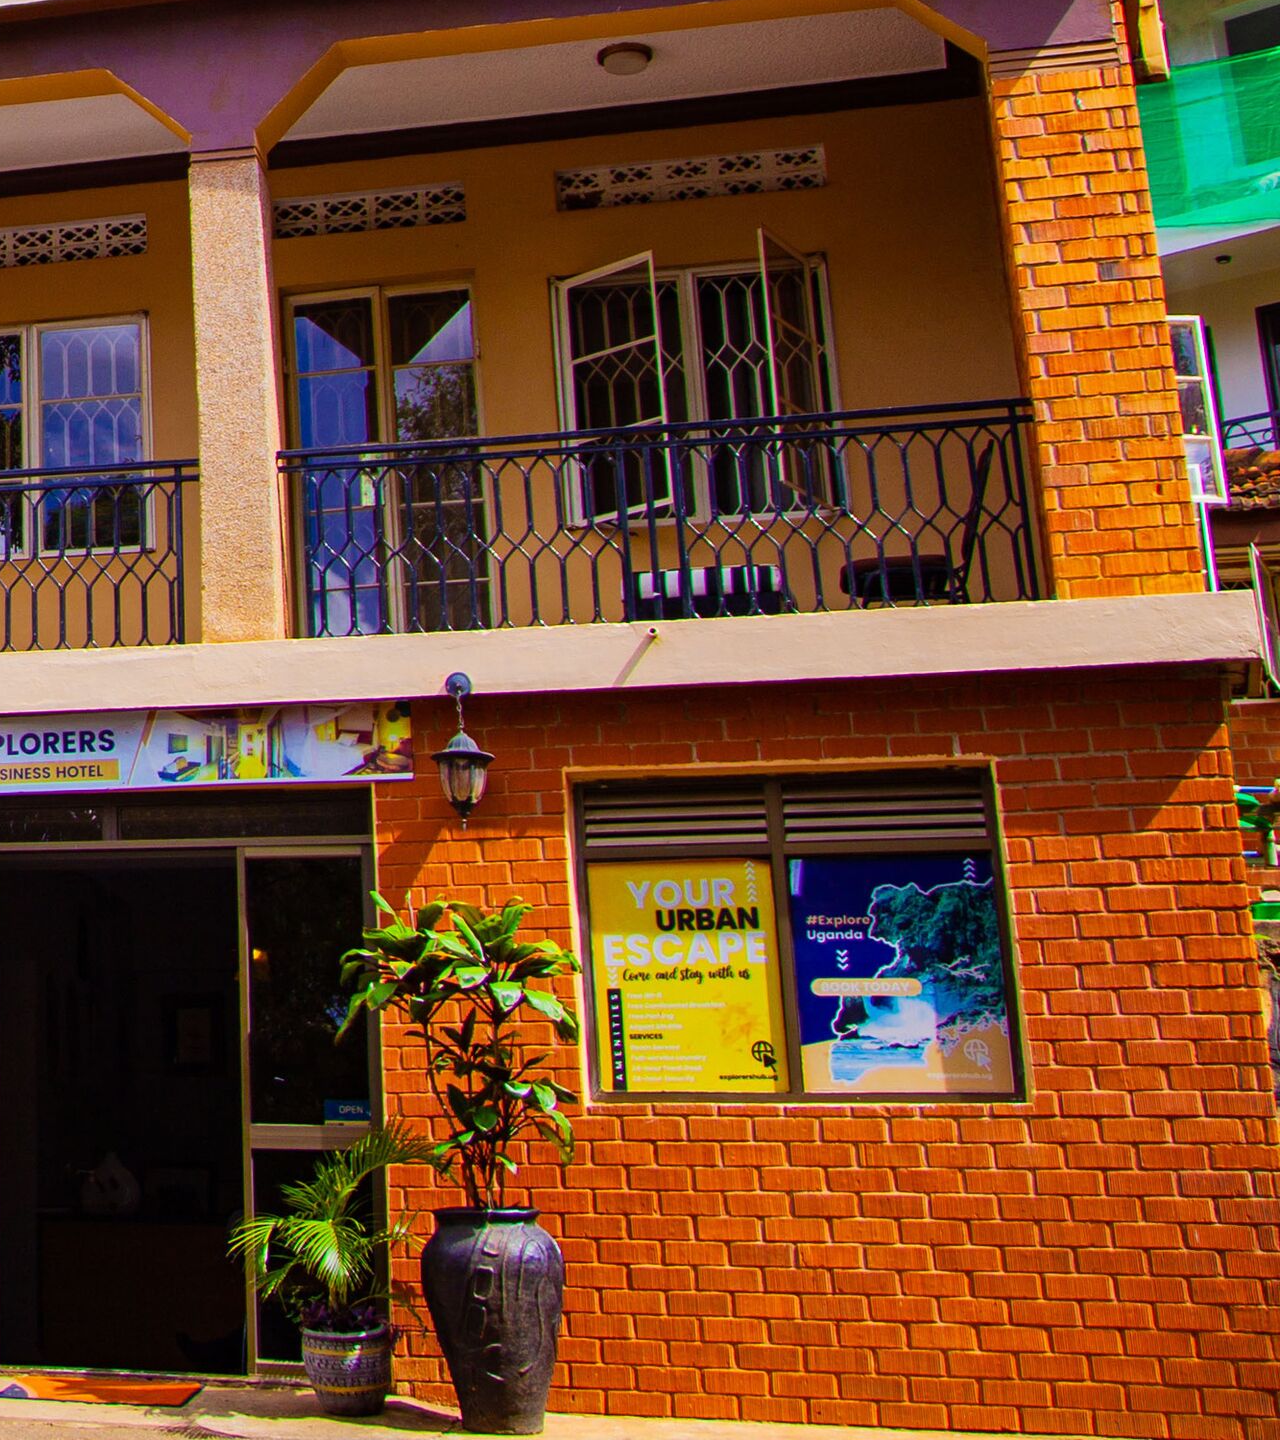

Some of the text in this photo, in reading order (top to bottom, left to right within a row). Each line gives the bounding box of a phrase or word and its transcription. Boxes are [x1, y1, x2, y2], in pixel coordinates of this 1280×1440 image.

[56, 764, 104, 779] HOTEL
[626, 877, 737, 910] YOUR
[655, 906, 760, 931] URBAN
[806, 914, 871, 928] #Explore
[806, 929, 864, 944] Uganda
[602, 931, 769, 967] ESCAPE
[622, 966, 650, 981] Come
[655, 966, 679, 981] and
[708, 965, 733, 980] with
[738, 969, 751, 980] us
[821, 980, 911, 993] BOOK TODAY
[610, 993, 624, 1082] AMENITIES
[339, 1104, 364, 1115] OPEN
